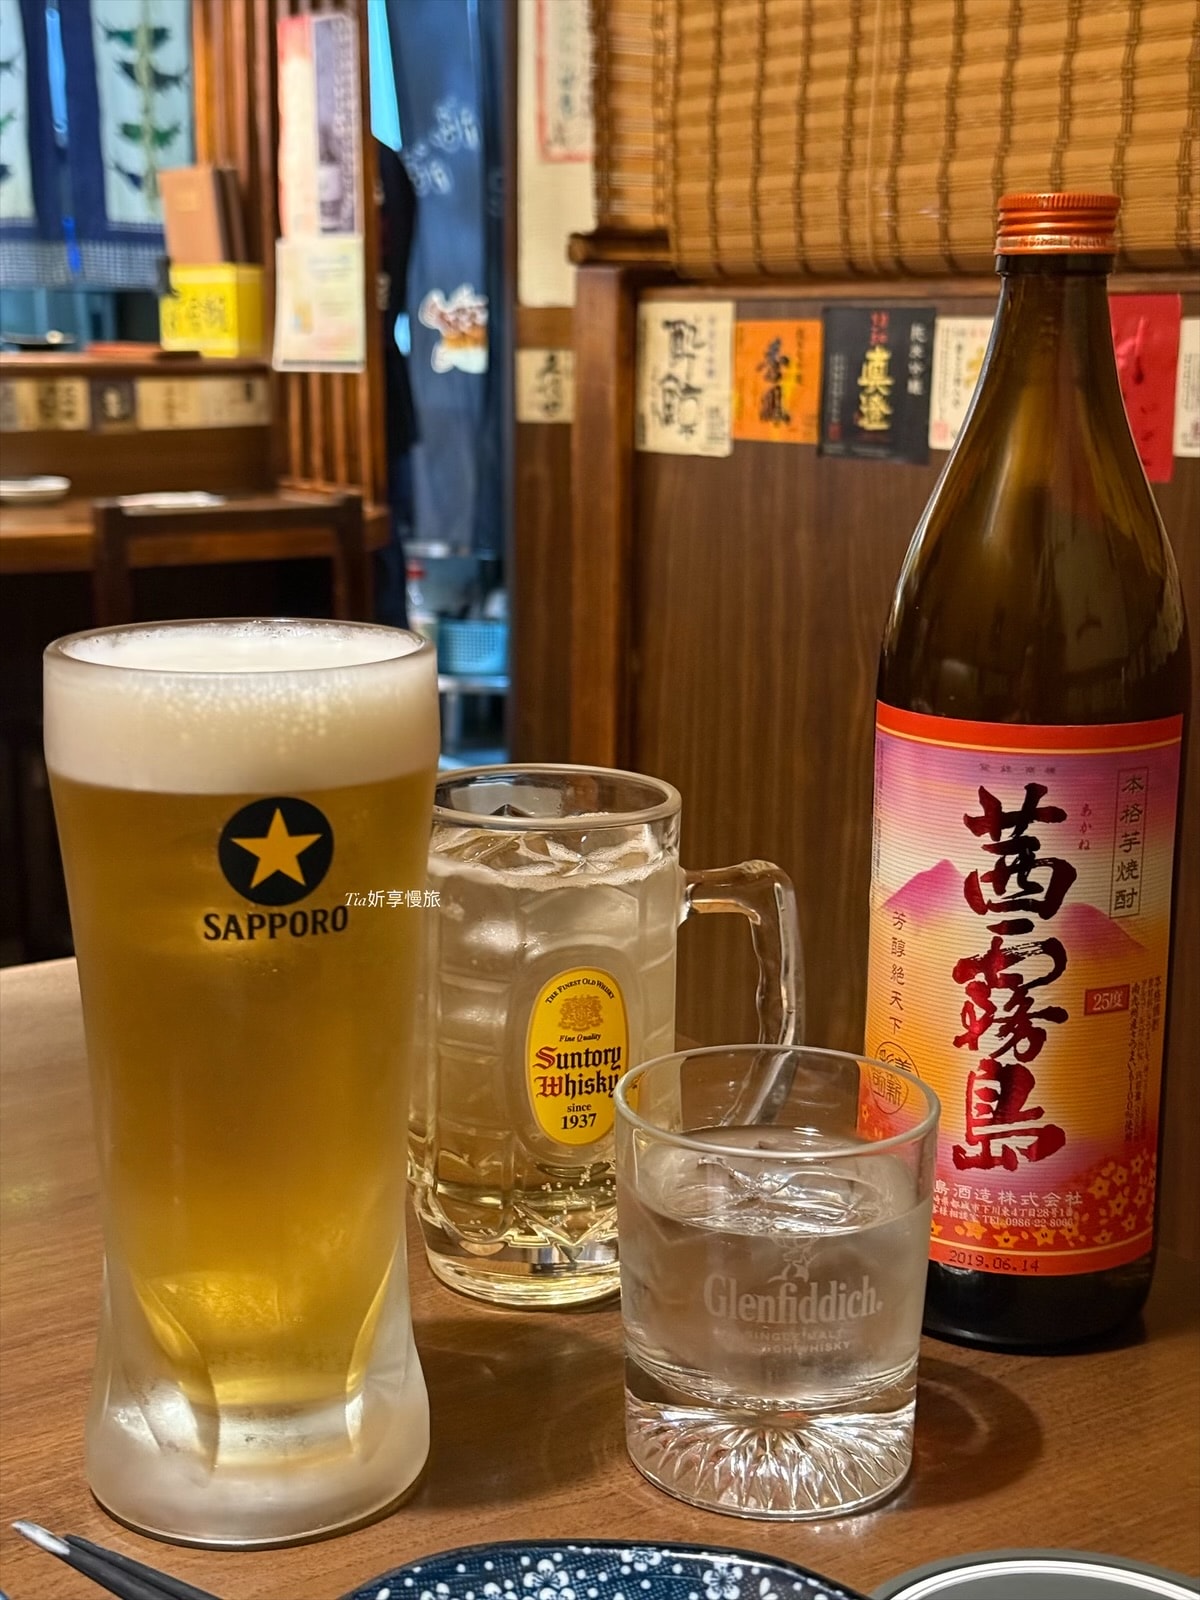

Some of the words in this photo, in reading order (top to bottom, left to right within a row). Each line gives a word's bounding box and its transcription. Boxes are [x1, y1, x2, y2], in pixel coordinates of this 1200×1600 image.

[857, 345, 895, 431] 真澄
[1077, 803, 1093, 852] あかね
[1113, 775, 1145, 912] 本格芋焼酎
[203, 905, 349, 941] SAPPORO
[545, 991, 558, 1004] THE
[556, 979, 581, 994] FINEST
[582, 977, 596, 986] OLD
[595, 980, 615, 999] WHISKY
[951, 781, 1078, 1172] 茜霧島
[1092, 990, 1123, 1012] 25度
[559, 1034, 575, 1042] Fine
[576, 1033, 602, 1042] Quality
[532, 1045, 622, 1071] Suntory
[533, 1070, 620, 1100] Whisky
[561, 1113, 597, 1130] 1937
[567, 1103, 592, 1113] since
[948, 1250, 1040, 1273] 2019.06.14
[703, 1273, 878, 1324] Glenfiddich
